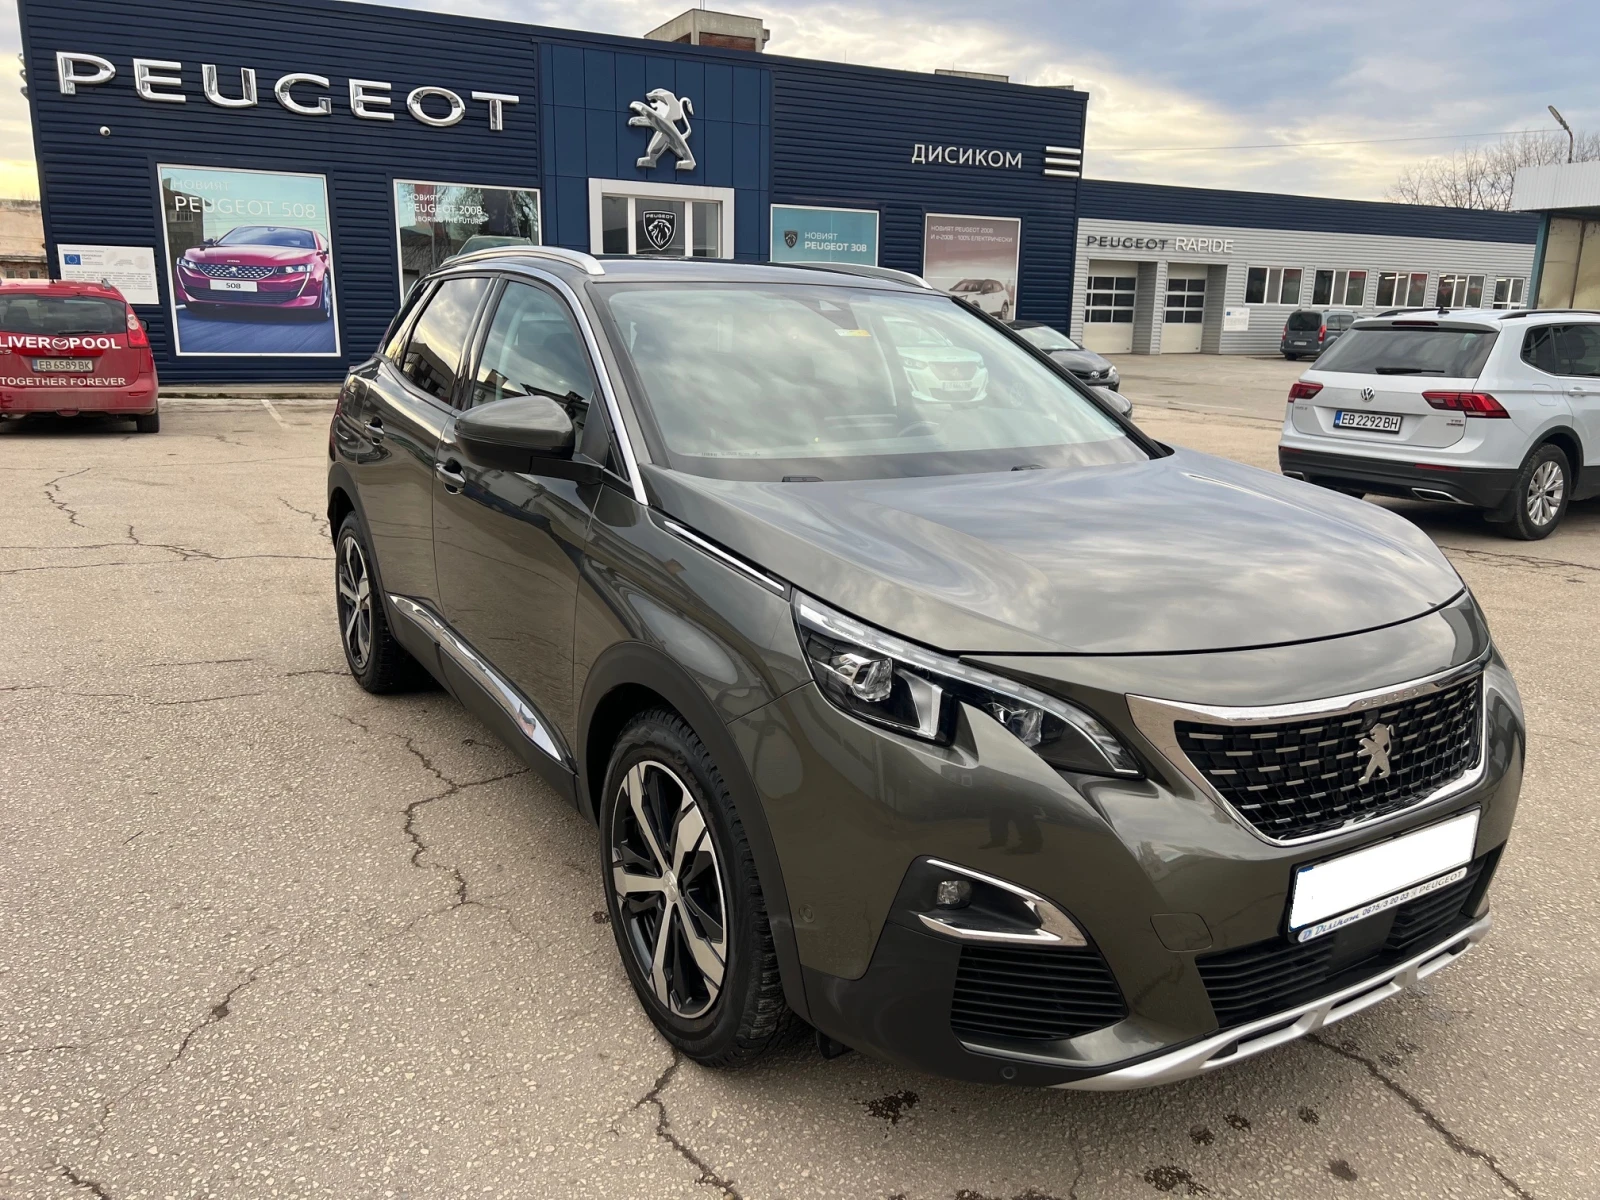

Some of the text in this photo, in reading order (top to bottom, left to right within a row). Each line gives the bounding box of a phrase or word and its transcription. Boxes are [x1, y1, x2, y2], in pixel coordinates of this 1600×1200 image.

[55, 51, 520, 131] PEUGEOT
[911, 143, 1022, 169] ДИСИКОМ
[172, 179, 231, 191] НОВИЯТ
[406, 193, 439, 202] НОВИЯТ
[174, 195, 316, 219] PEUGEOT 508
[407, 202, 483, 215] PEUGEOT 2008
[458, 217, 483, 225] FUTURE
[804, 232, 838, 240] НОВИЯТ
[804, 241, 867, 252] PEUGEOT 308
[1086, 235, 1234, 254] PEUGEOT RAPIDE
[38, 360, 91, 370] EB 6589 BK
[0, 376, 126, 386] TOGETHER FOREVER
[1341, 413, 1399, 430] EB 2292 BH
[1418, 872, 1463, 893] PEUGEOT
